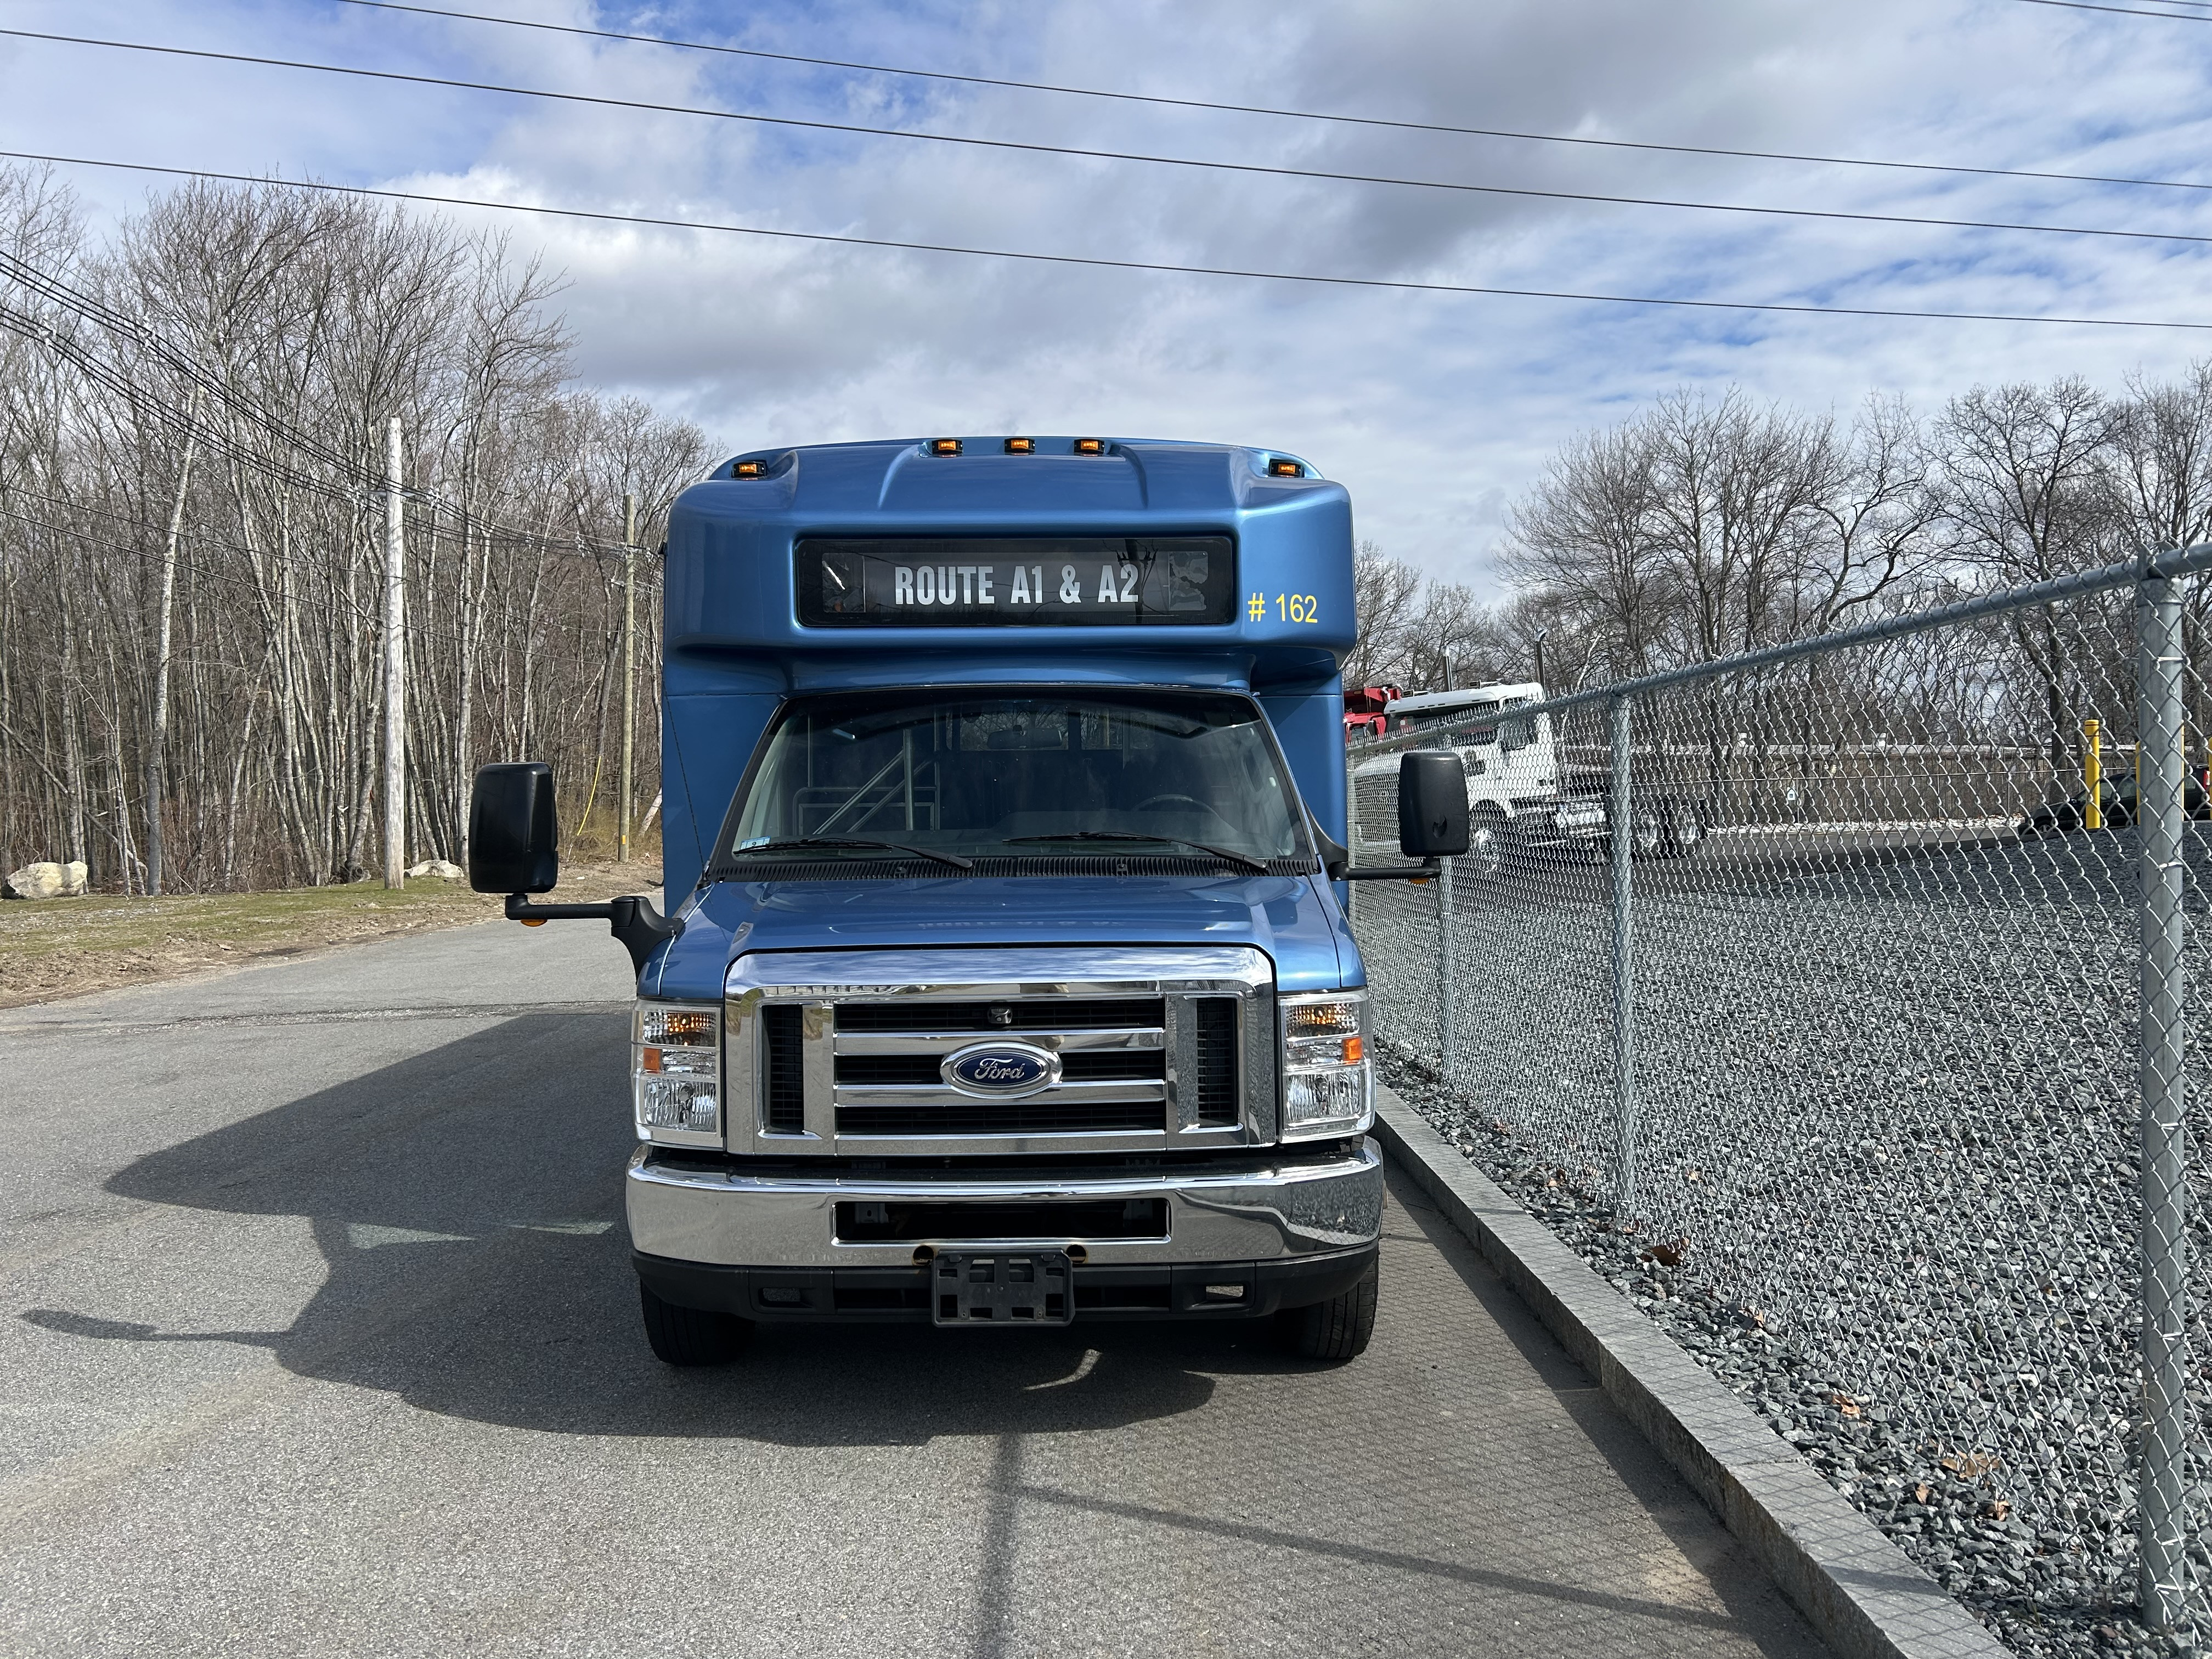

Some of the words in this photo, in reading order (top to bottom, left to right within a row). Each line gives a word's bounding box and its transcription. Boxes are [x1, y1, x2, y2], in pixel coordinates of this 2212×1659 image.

[895, 566, 995, 605] ROUTE
[1011, 565, 1043, 604] A1
[1059, 564, 1081, 604] &
[1098, 563, 1138, 603] A2
[1248, 592, 1266, 622] #
[1276, 593, 1318, 623] 162
[974, 1058, 1025, 1080] Ford
